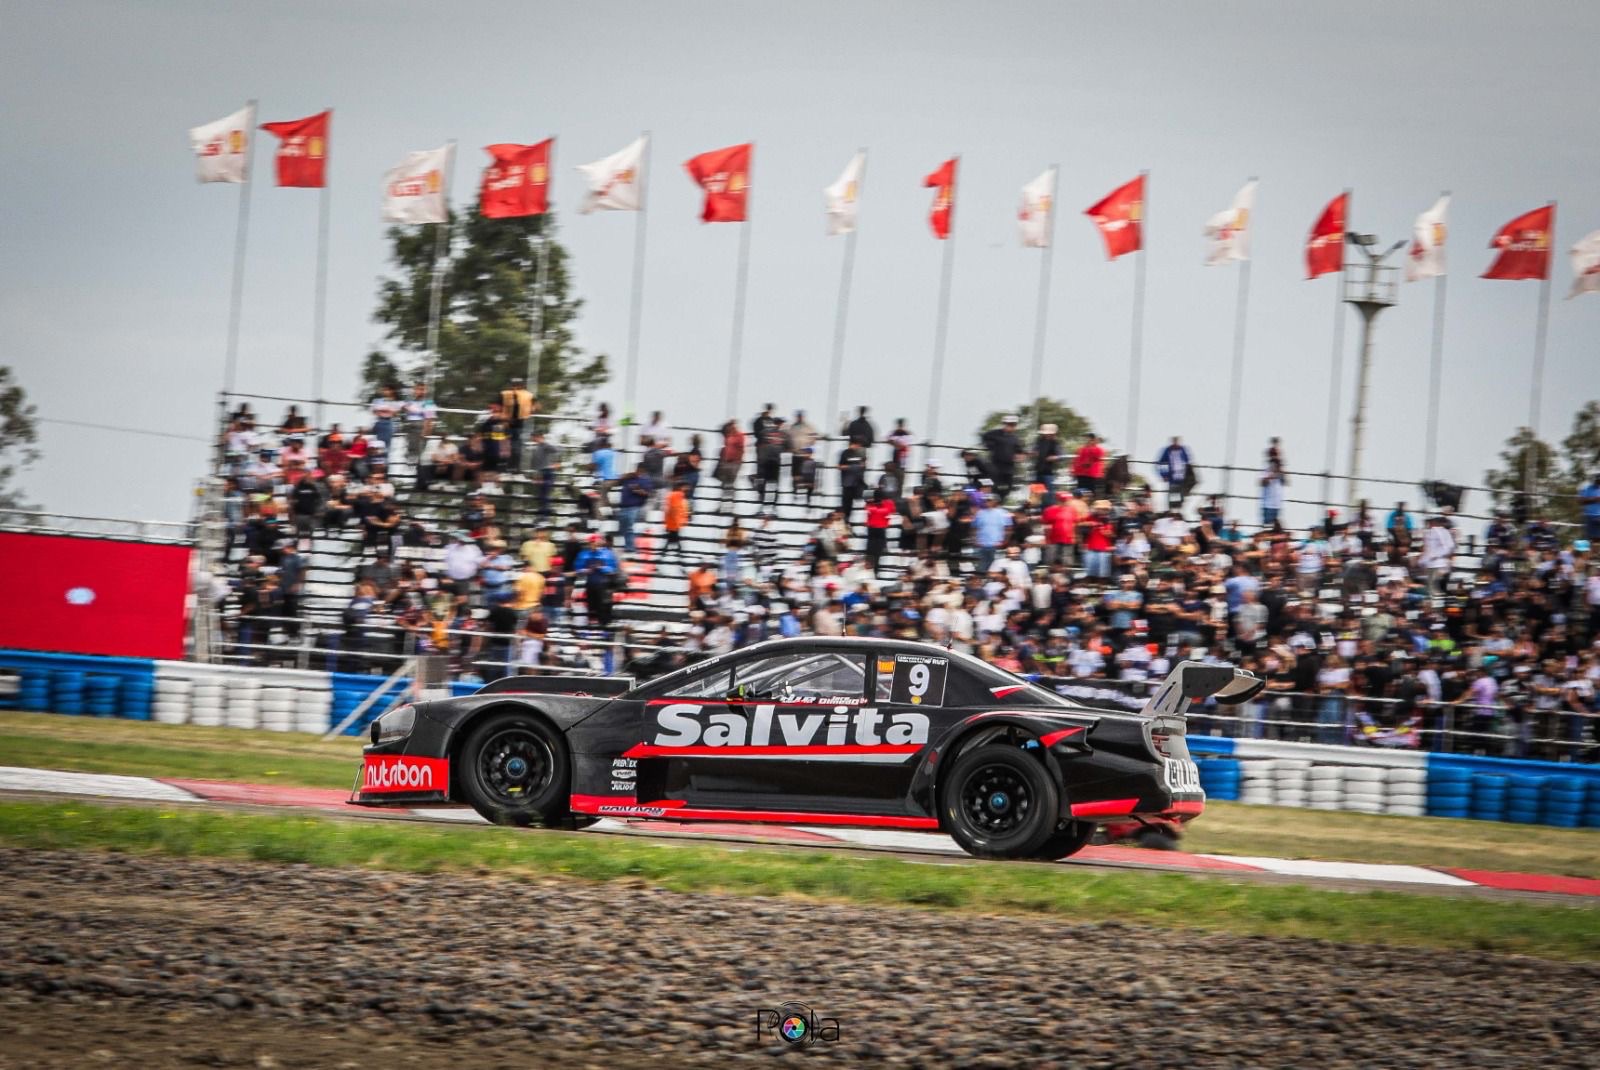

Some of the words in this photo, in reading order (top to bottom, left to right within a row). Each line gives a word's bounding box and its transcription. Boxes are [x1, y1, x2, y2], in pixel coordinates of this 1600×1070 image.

[908, 663, 930, 696] 9
[654, 703, 930, 747] Salvita
[366, 759, 433, 788] nutribon
